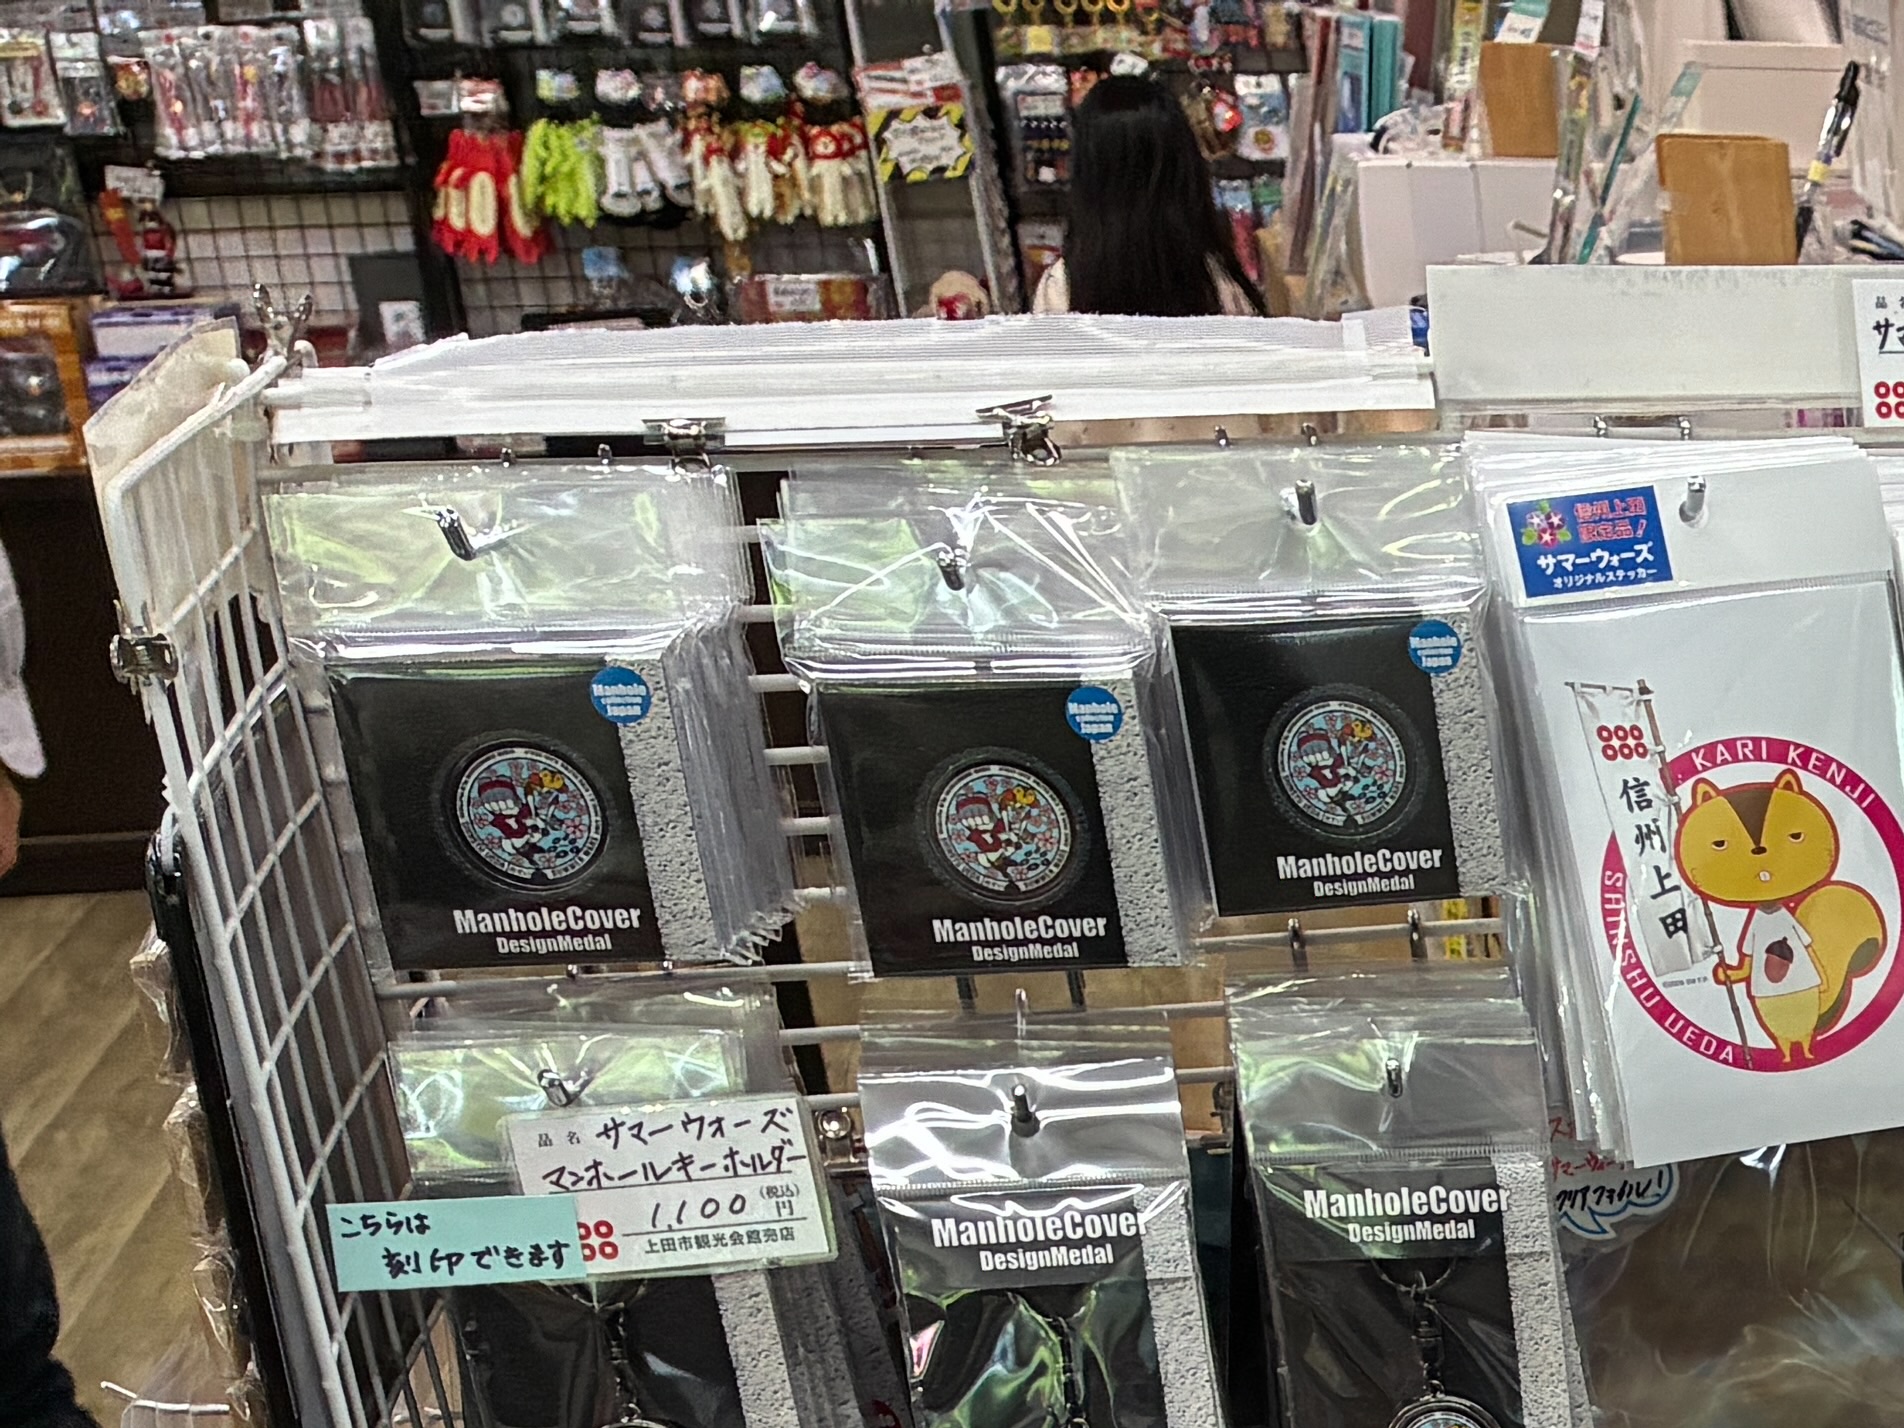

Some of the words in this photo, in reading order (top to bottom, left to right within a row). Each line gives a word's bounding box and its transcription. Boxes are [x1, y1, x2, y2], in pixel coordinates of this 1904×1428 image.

[1537, 541, 1654, 575] サマーウォーズ
[1553, 568, 1657, 589] オリジナルステッカー
[1691, 739, 1767, 772] KARI
[1787, 745, 1876, 809] KENJI
[1276, 846, 1443, 881] ManholeCover
[1619, 777, 1688, 940] 信州上田
[1313, 874, 1415, 898] DesignMedal
[452, 906, 640, 934] ManholeCover
[933, 916, 1107, 943] ManholeCover
[496, 936, 612, 955] DesignMedal
[972, 943, 1079, 962] DesignMedal
[1665, 1012, 1734, 1064] UEDA
[596, 1108, 793, 1148] サマーウォーズ
[543, 1140, 807, 1191] マンホールキーホルダー
[1304, 1184, 1511, 1219] ManholeCover
[340, 1212, 430, 1237] こちらは
[932, 1212, 1150, 1249] ManholeCover
[1348, 1219, 1476, 1245] DesignMedal
[645, 1226, 794, 1255] 上田市観光会館売店
[383, 1240, 570, 1278] 刻印できます
[979, 1244, 1114, 1273] DesignMedal
